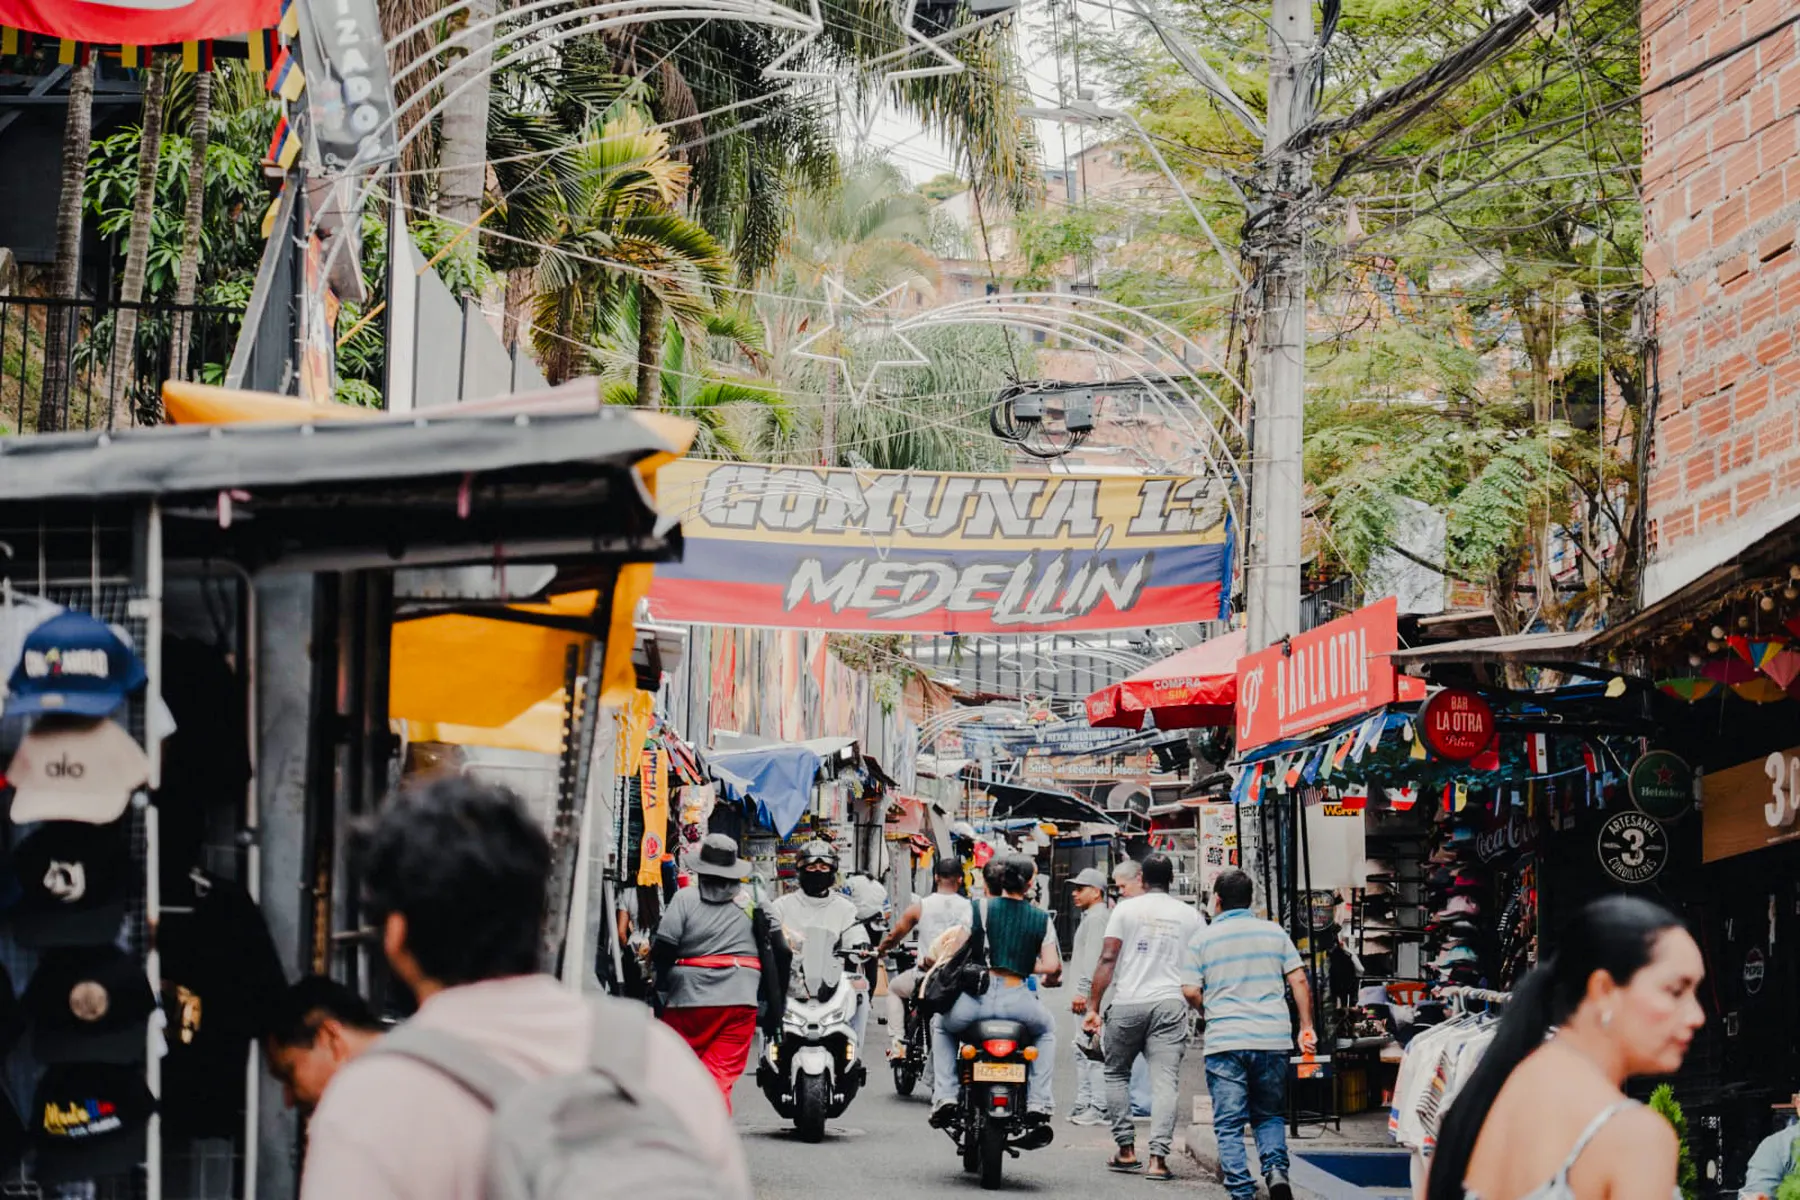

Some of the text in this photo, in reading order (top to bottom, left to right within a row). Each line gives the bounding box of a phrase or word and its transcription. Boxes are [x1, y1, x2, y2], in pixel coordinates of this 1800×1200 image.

[701, 464, 1226, 539] COMUNA 13
[1152, 677, 1201, 692] COMPRA
[1277, 648, 1307, 721] BAR
[1309, 640, 1327, 706] LA
[1329, 626, 1369, 701] OTRA
[1167, 688, 1188, 700] SIM
[1451, 695, 1468, 711] BAR
[1436, 710, 1483, 733] LA OTRA
[45, 752, 84, 779] alo
[1640, 786, 1686, 798] Heineken
[1608, 815, 1658, 838] ARTESANAL
[1621, 828, 1645, 866] 3
